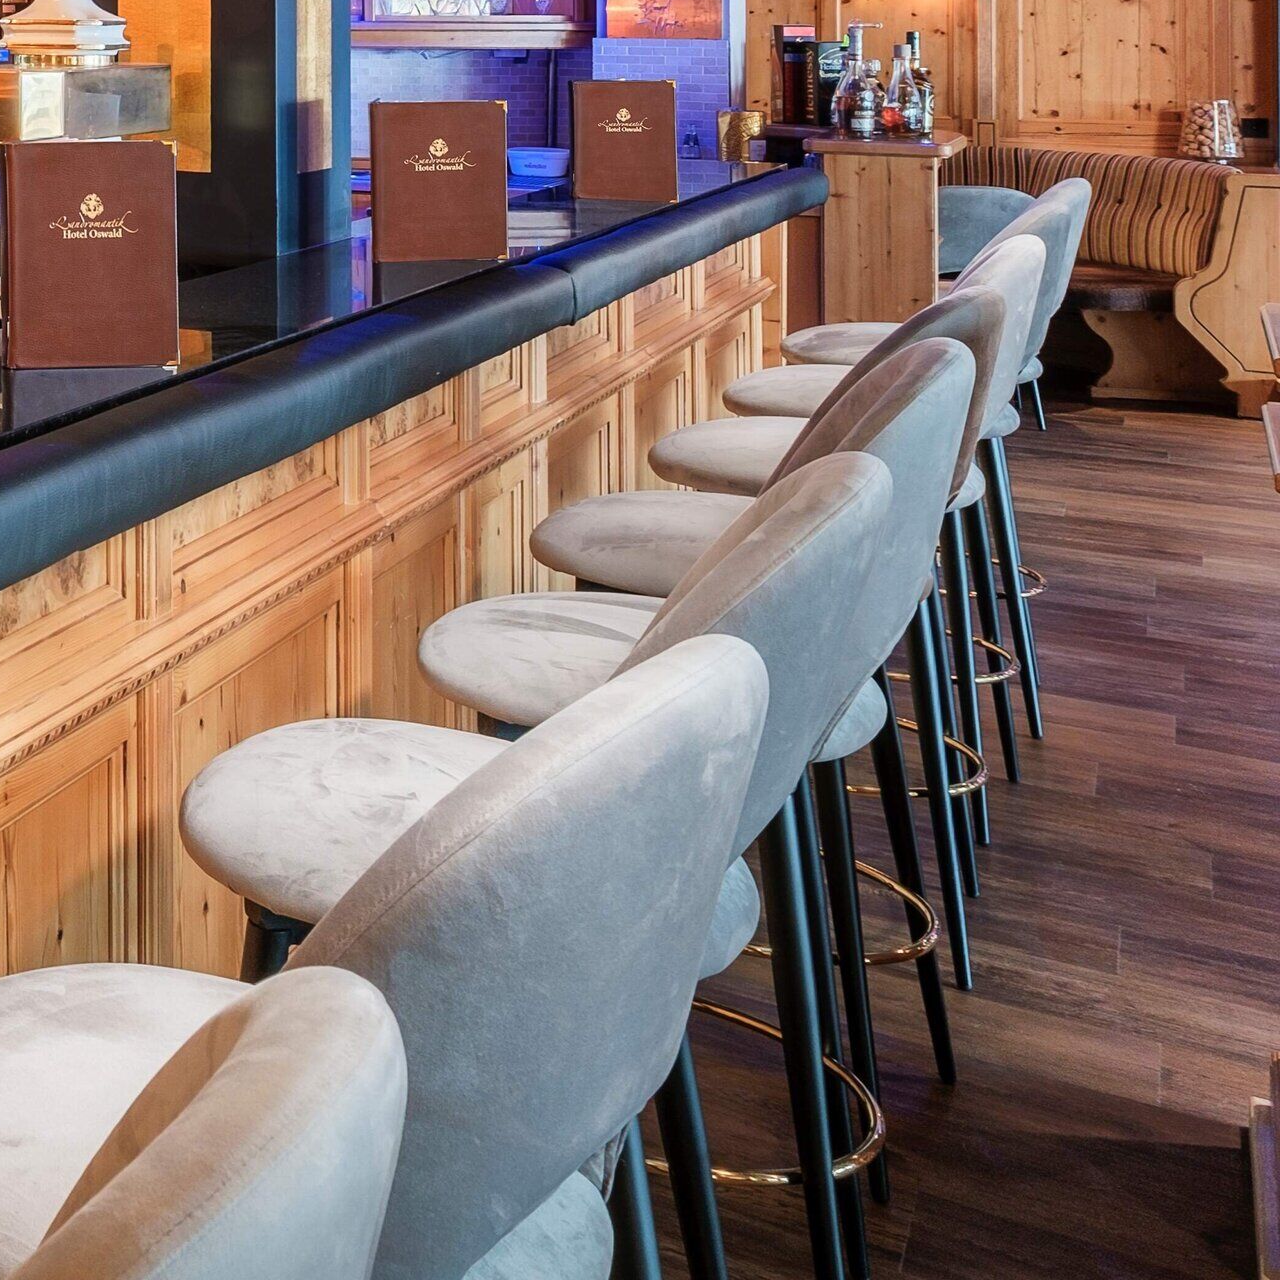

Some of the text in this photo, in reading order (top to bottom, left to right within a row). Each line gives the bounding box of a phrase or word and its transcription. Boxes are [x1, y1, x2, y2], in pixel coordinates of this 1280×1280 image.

[806, 48, 815, 119] Hennessy
[403, 150, 477, 167] Landromantik
[415, 163, 464, 171] Hotel Oswald
[49, 210, 139, 234] Landromantik
[62, 228, 123, 239] Hotel Oswald
